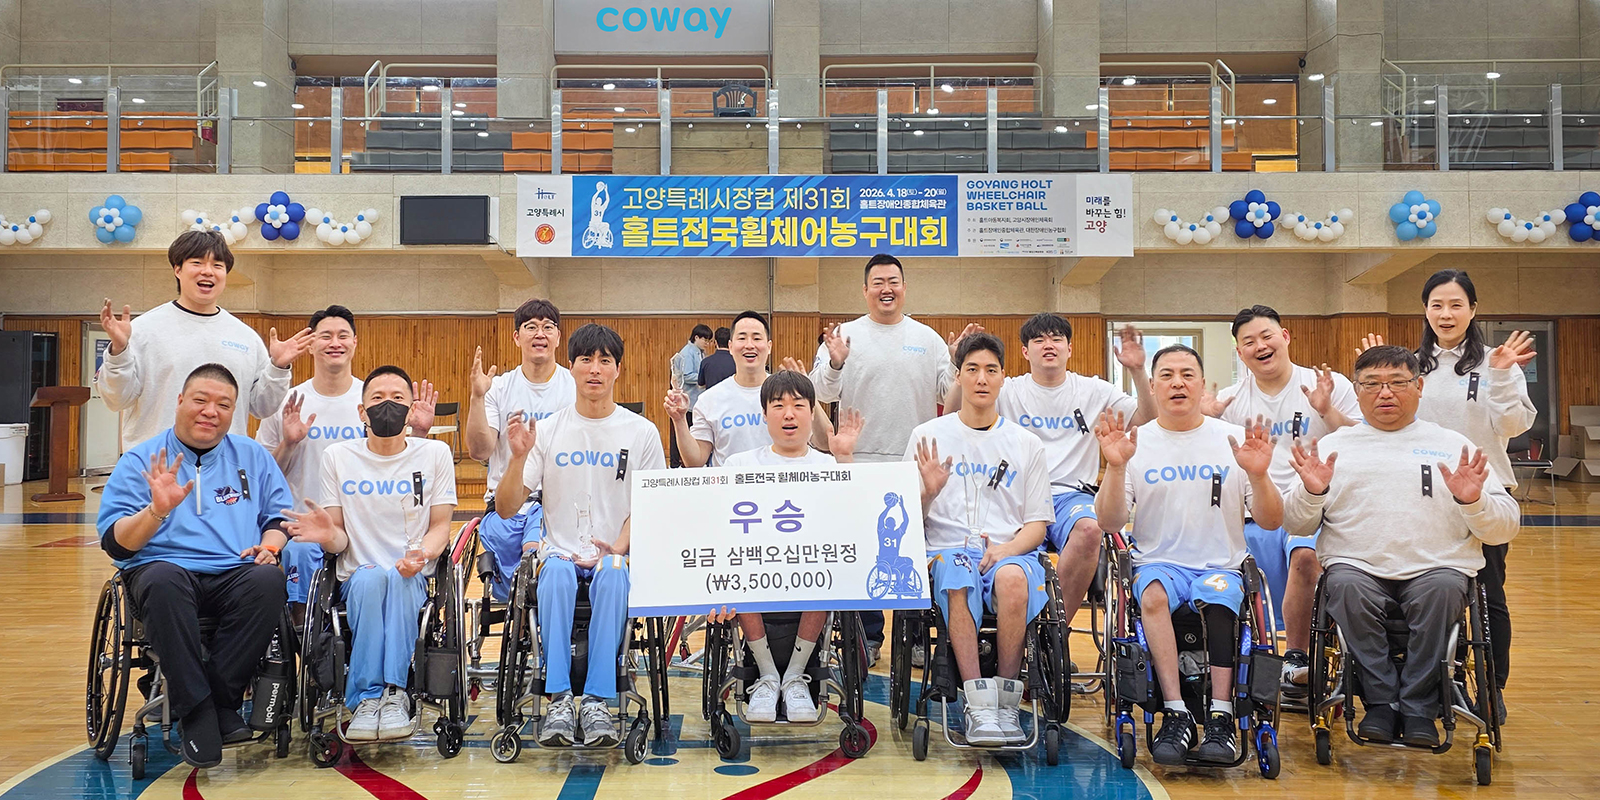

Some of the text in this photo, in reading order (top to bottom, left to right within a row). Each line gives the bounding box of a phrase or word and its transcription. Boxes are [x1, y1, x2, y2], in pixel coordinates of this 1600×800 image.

[966, 180, 1053, 189] GOYANG HOLT
[622, 186, 851, 210] 고양특례시장컵 제31회
[859, 188, 885, 197] 2026.
[966, 190, 1046, 200] WHEELCHAIR
[860, 199, 947, 209] 홀트장애인종합체육관
[966, 201, 1048, 211] BASKET BALL
[1085, 196, 1111, 206] 미래를
[526, 208, 565, 217] 고양특례시
[1085, 208, 1126, 219] 바꾸는 힘!
[621, 216, 948, 248] 홀트전국휠체어농구대회
[1084, 220, 1107, 233] 고양
[721, 413, 768, 429] cow
[1019, 414, 1082, 432] cowa
[555, 450, 621, 473] cowa
[1412, 449, 1453, 460] coway
[641, 469, 851, 489] 고양특례시장컵 제31회 홀트전국 휠체어농구대회
[341, 479, 427, 496] cowa
[884, 537, 897, 548] 31
[680, 543, 858, 568] 일금 삼백오십만원정
[705, 569, 834, 594] (₩3,500,000)
[1203, 573, 1229, 592] 4
[265, 682, 280, 723] permobil
